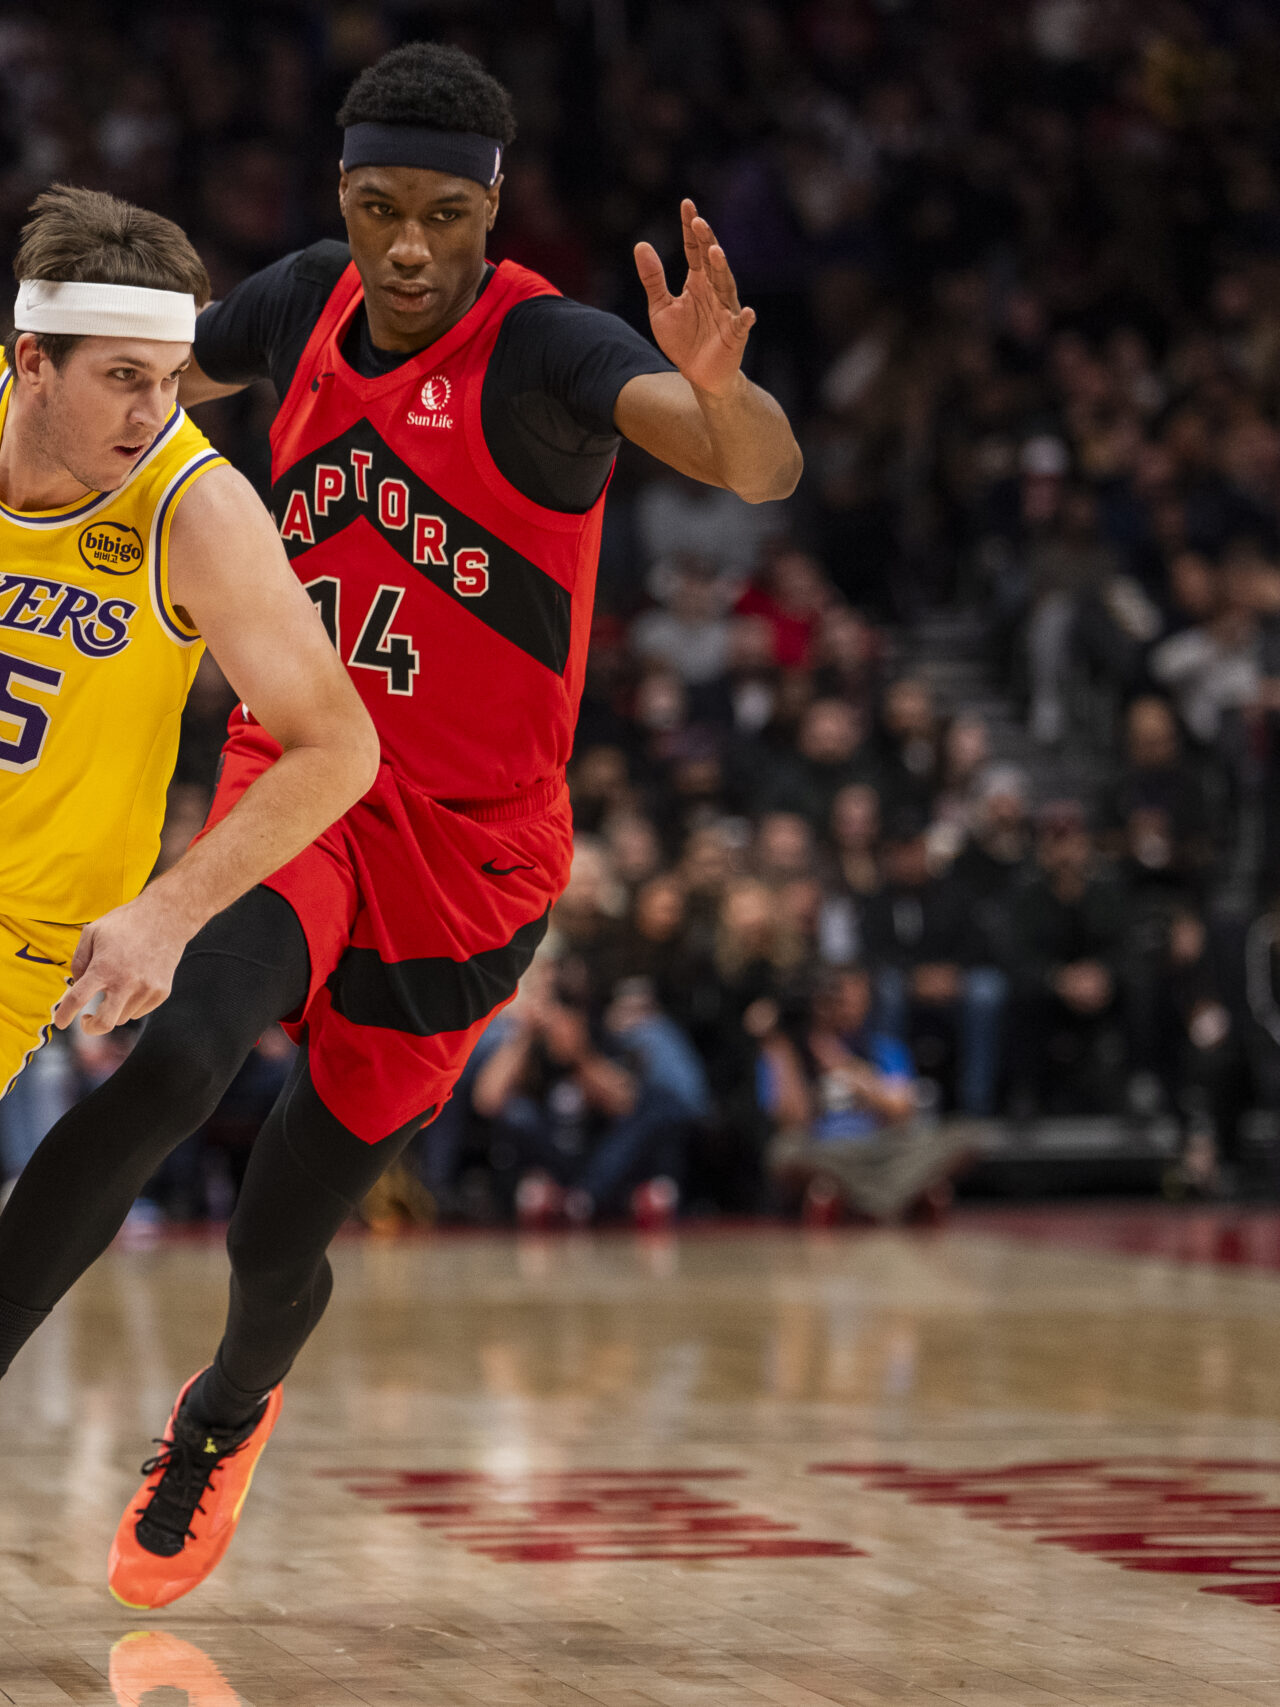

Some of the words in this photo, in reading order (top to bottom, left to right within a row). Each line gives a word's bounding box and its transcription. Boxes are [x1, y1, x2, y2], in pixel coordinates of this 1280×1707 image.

[406, 411, 430, 426] Sun
[431, 413, 454, 429] Life
[271, 448, 489, 597] APTORS
[85, 532, 141, 563] bibigo
[93, 550, 118, 564] 비비고
